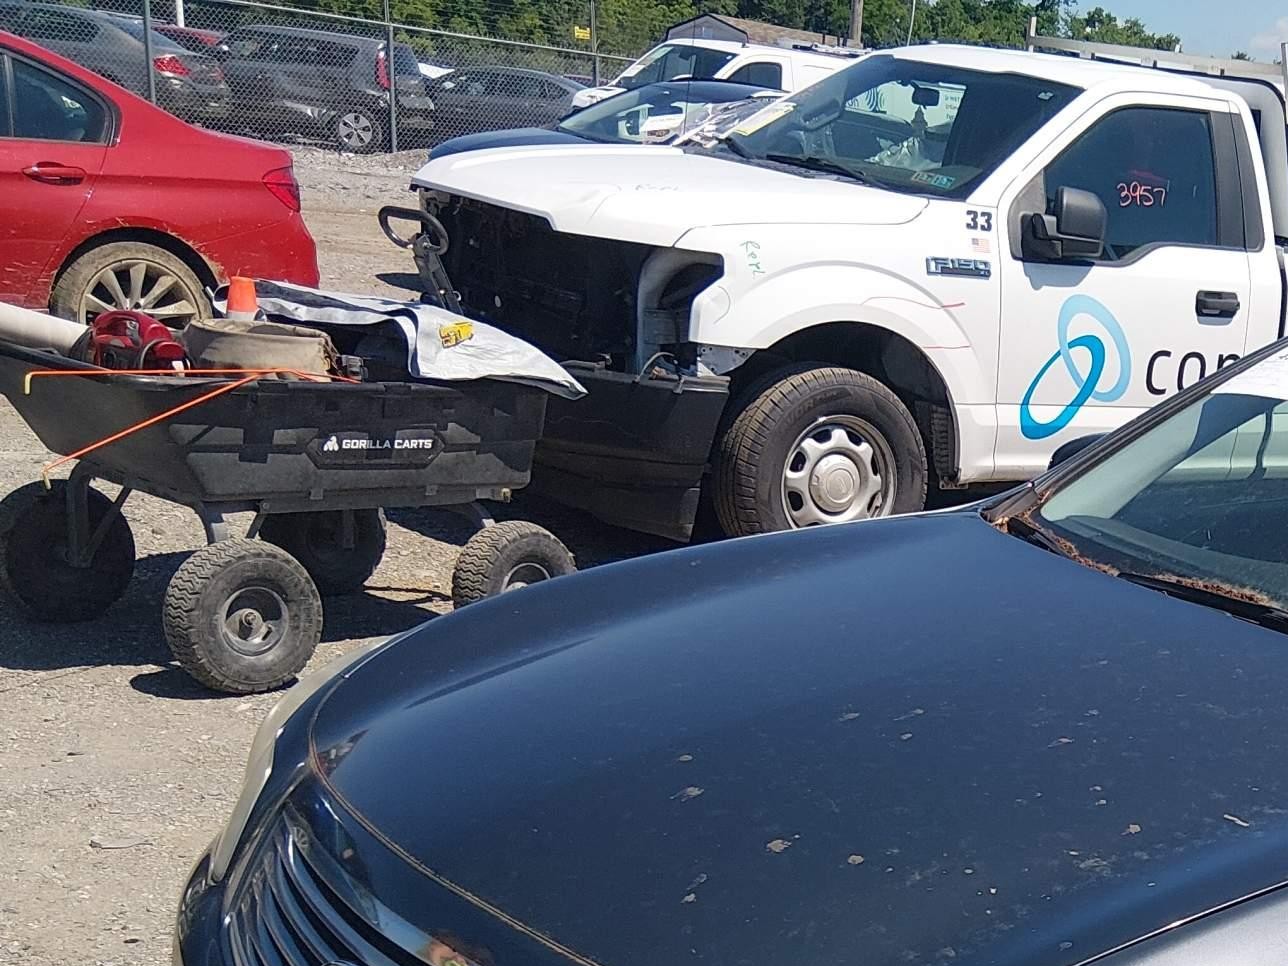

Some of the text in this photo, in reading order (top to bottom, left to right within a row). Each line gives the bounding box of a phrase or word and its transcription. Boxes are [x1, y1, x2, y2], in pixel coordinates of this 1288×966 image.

[1117, 181, 1166, 207] 3957
[965, 210, 992, 232] 33
[342, 439, 433, 449] GORILLA CARTS
